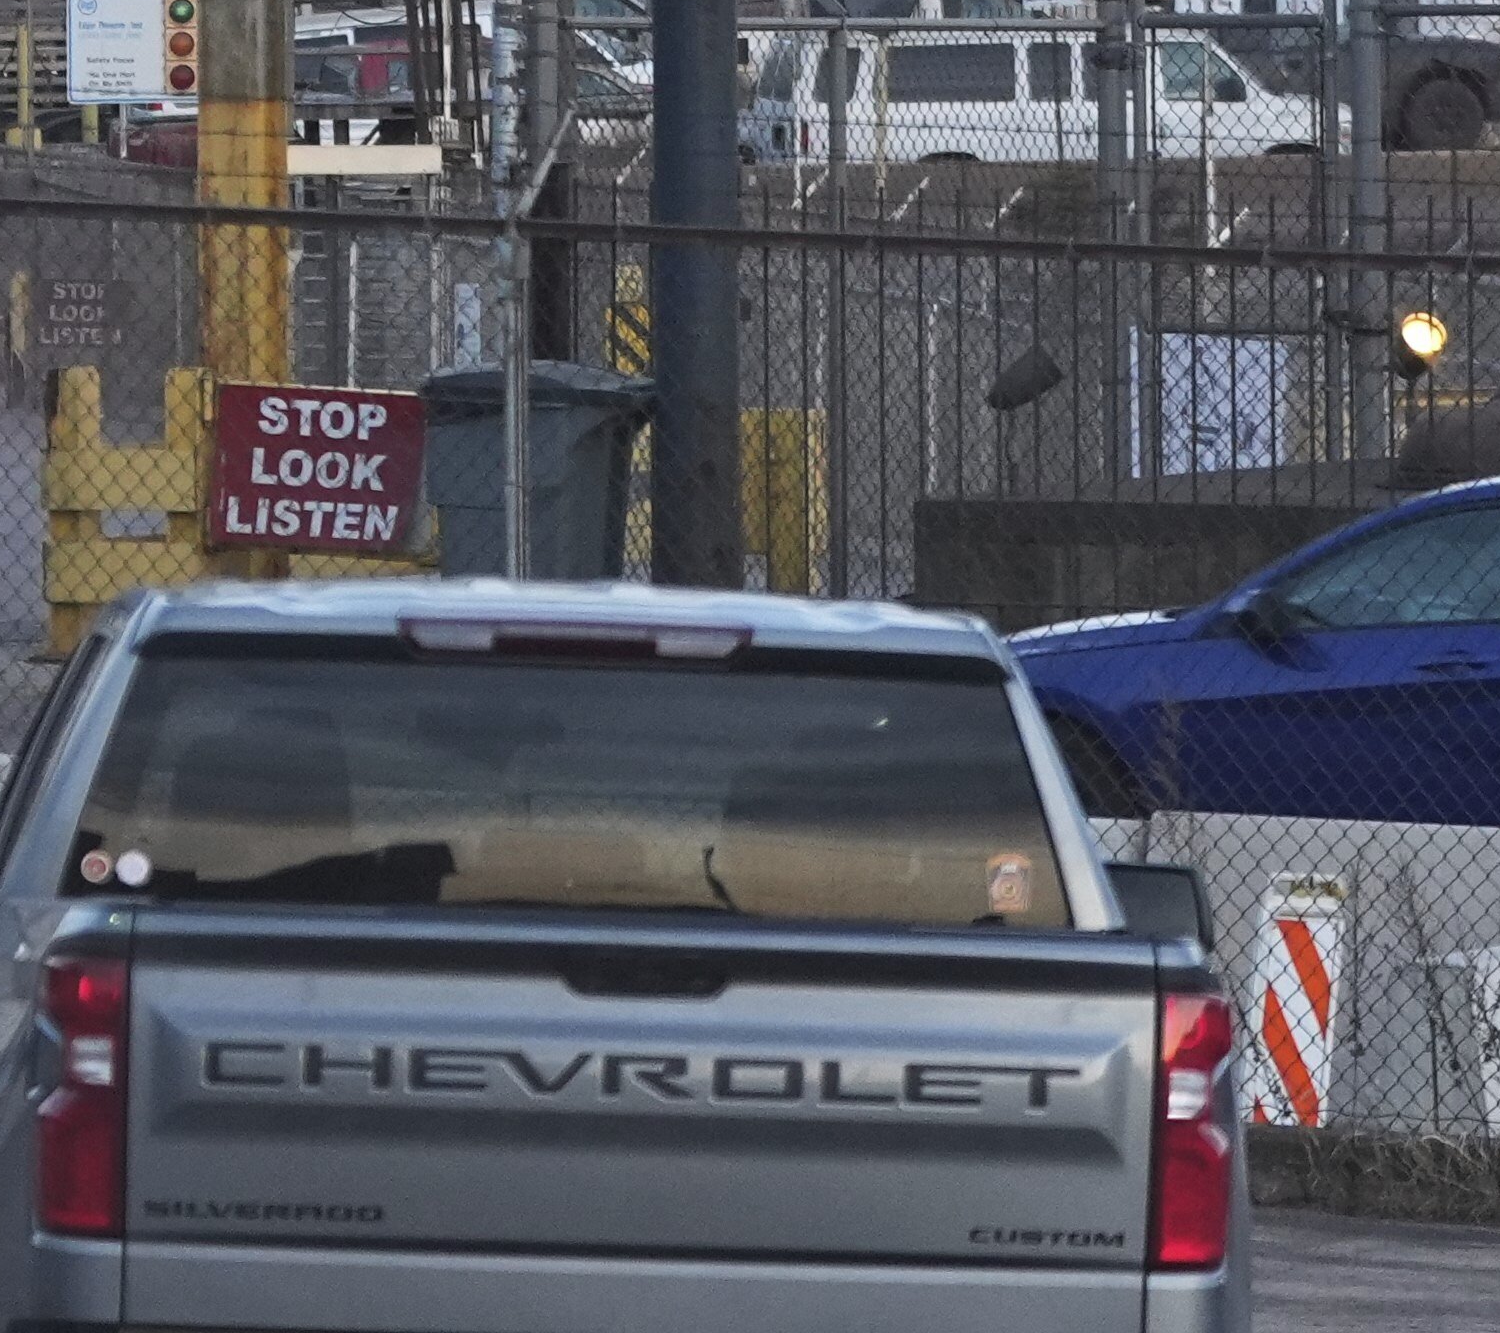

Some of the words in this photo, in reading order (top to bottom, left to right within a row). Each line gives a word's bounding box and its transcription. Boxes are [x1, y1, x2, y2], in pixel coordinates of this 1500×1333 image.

[257, 396, 388, 441] STOP
[250, 446, 390, 492] LOOK
[225, 494, 400, 542] LISTEN
[203, 1040, 1083, 1115] CHEVROLET
[144, 1199, 384, 1223] SILVERADO
[967, 1226, 1126, 1248] CUSTOM
